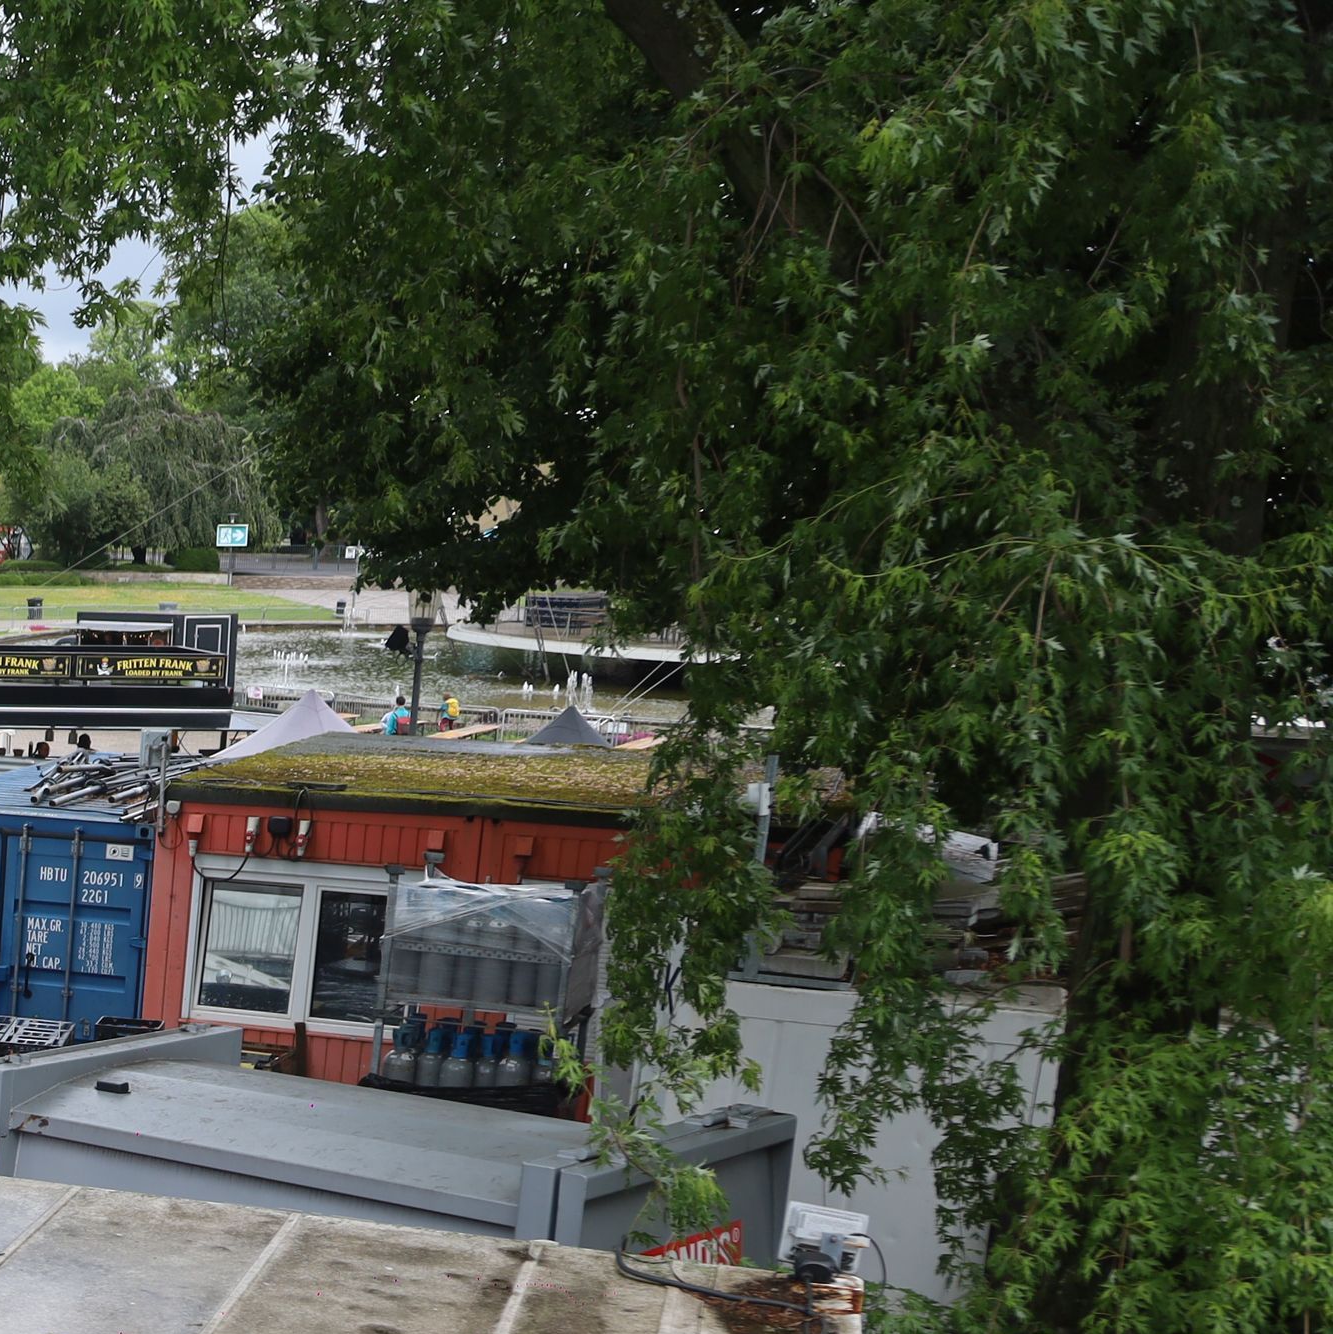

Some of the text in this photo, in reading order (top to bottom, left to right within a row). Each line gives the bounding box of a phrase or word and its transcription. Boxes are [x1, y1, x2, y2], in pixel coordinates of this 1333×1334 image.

[5, 656, 39, 670] FRANK
[117, 657, 193, 671] FRITTEN FRANK
[161, 669, 183, 677] FRANK
[39, 866, 143, 888] HBTU 206951 9
[81, 888, 109, 904] 22G1
[26, 930, 48, 943] TARE
[25, 943, 42, 956] NET
[42, 957, 62, 970] CAP.
